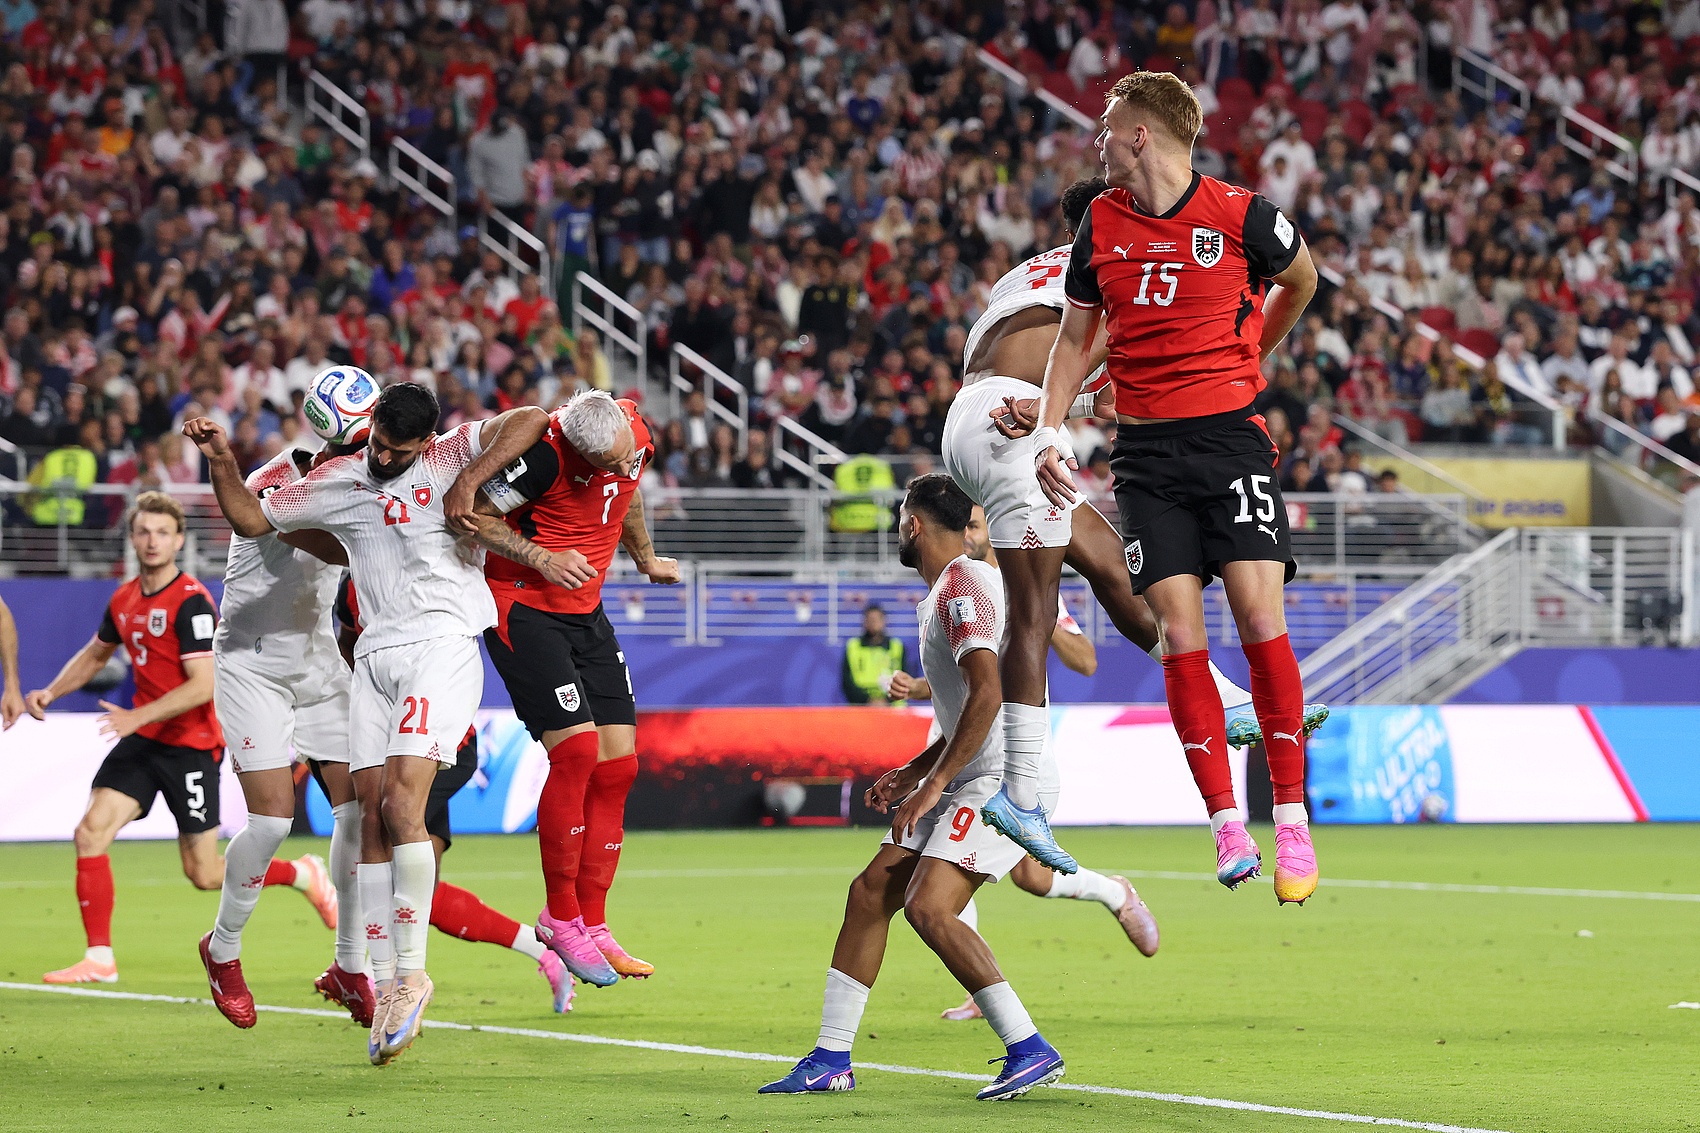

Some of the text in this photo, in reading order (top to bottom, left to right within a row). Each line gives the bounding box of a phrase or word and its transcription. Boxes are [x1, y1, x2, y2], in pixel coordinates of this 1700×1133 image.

[1133, 262, 1185, 306] 15
[376, 494, 411, 526] 21
[602, 482, 618, 525] 7
[1228, 474, 1276, 523] 15
[131, 630, 148, 667] 5
[398, 695, 430, 735] 21
[184, 770, 205, 810] 5
[948, 806, 976, 842] 9
[604, 842, 623, 851] ÖF
